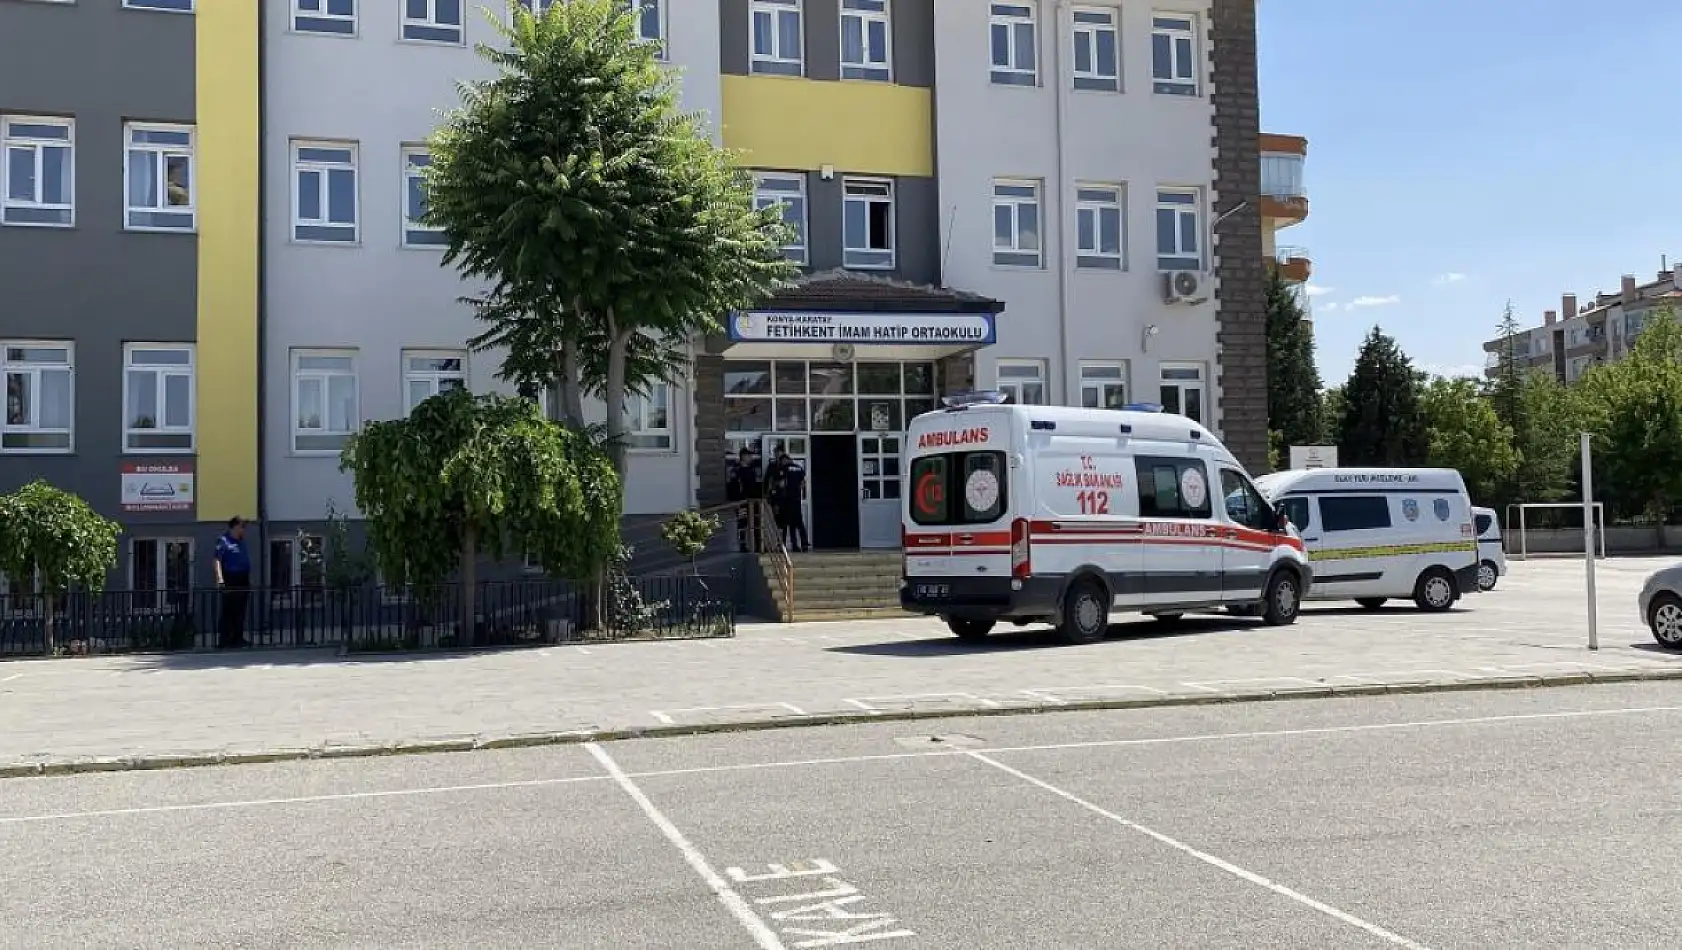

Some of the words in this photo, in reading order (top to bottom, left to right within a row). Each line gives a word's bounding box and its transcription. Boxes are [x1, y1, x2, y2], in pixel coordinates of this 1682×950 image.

[839, 323, 871, 338] İMAM
[873, 324, 909, 339] HATİP
[911, 326, 982, 339] ORTAOKULU
[918, 427, 989, 449] AMBULANS
[1077, 489, 1108, 515] 112
[1143, 521, 1207, 538] AMBULANS
